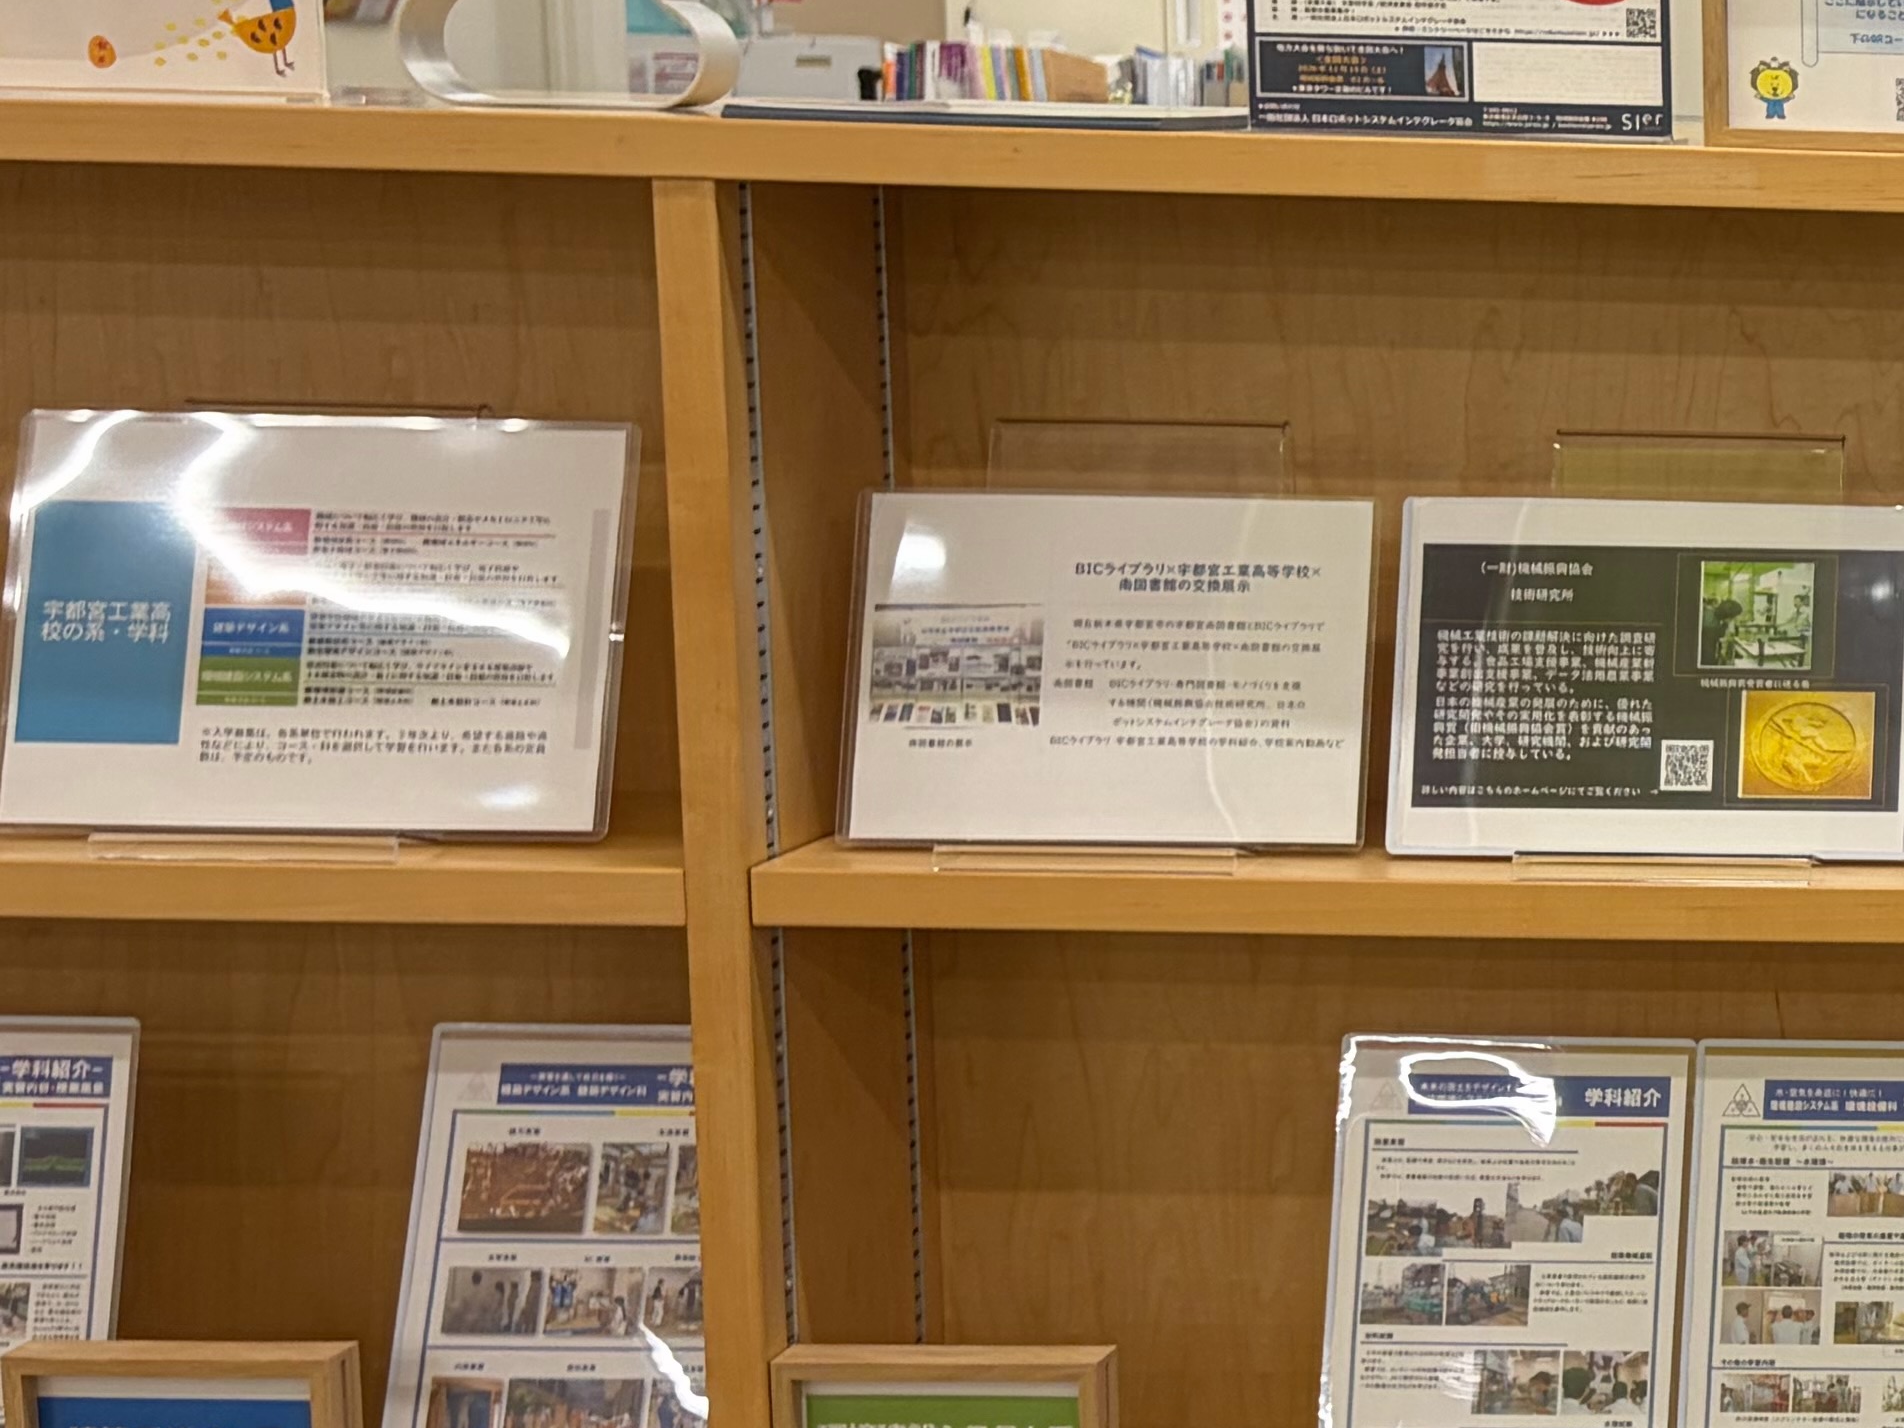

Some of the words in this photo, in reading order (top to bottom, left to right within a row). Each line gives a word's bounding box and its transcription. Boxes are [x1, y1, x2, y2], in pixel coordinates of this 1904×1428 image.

[41, 598, 172, 624] 宇都宮工業高
[40, 620, 170, 645] 校の系・学科
[1583, 1087, 1662, 1108] 学科紹介
